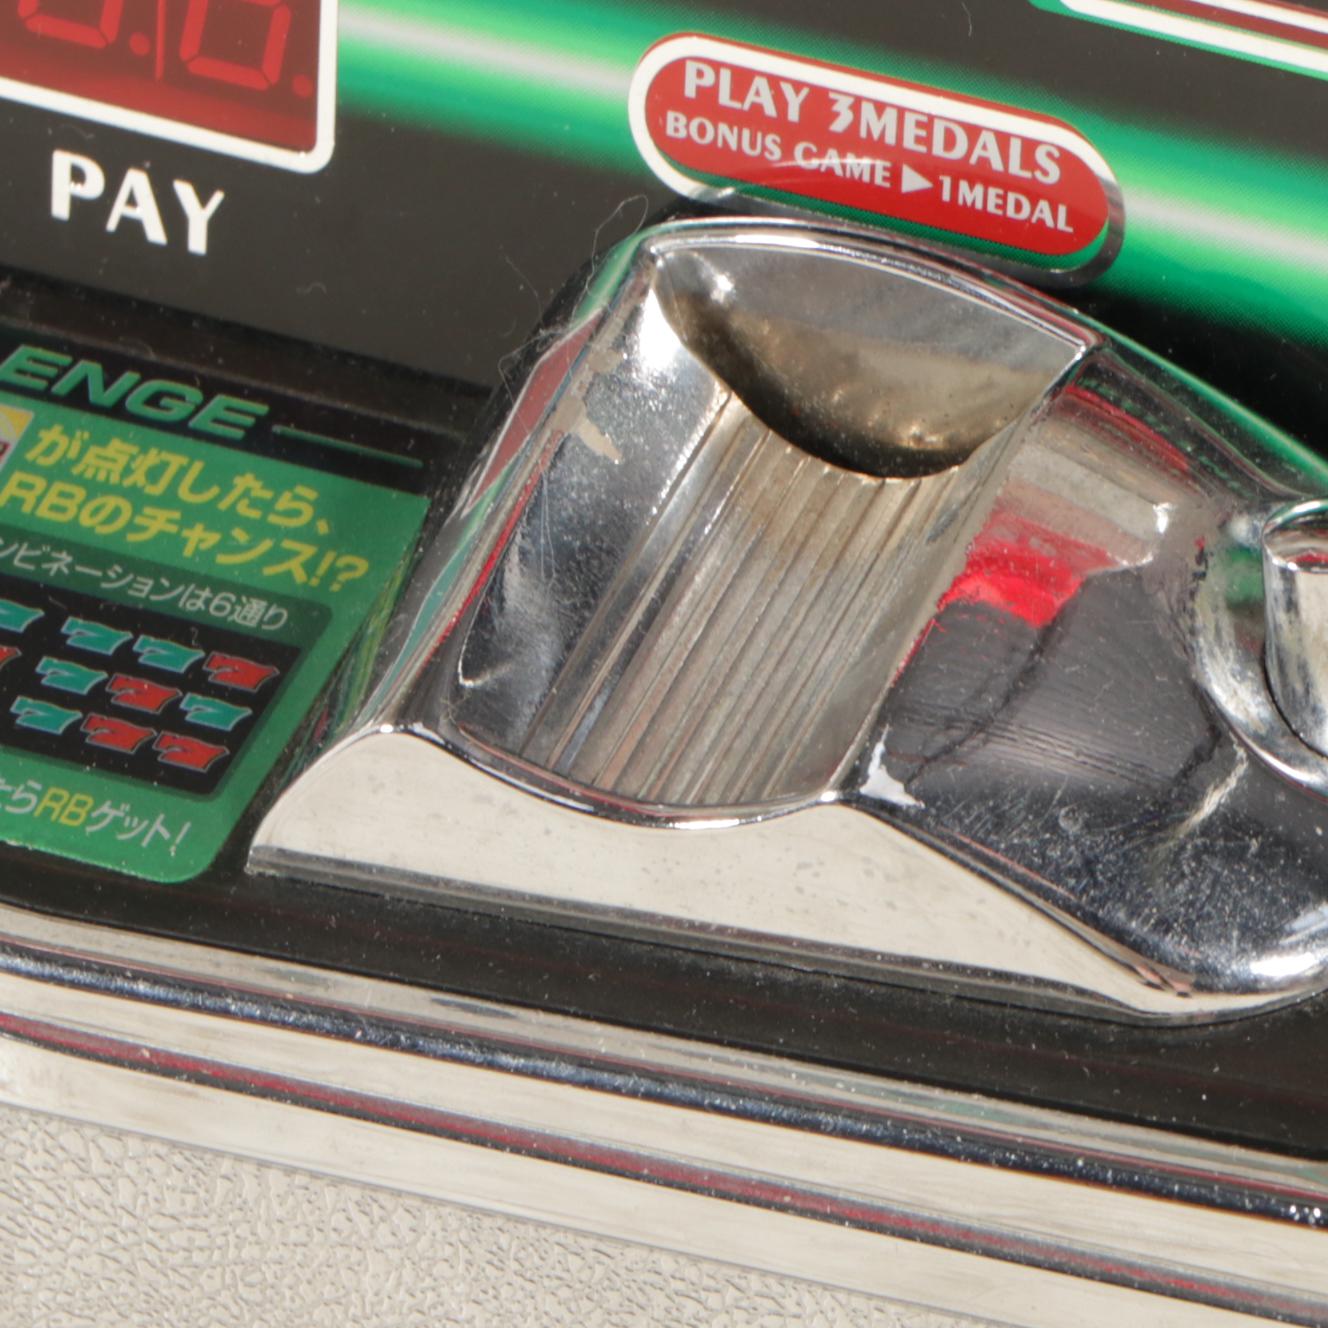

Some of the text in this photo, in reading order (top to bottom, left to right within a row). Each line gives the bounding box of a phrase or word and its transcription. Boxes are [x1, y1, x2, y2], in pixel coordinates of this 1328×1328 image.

[665, 110, 1075, 233] BONUS GAME 1MEDAL
[683, 59, 1062, 185] PLAY 3MEDALS
[50, 148, 225, 257] PAY
[0, 343, 270, 441] ENGE
